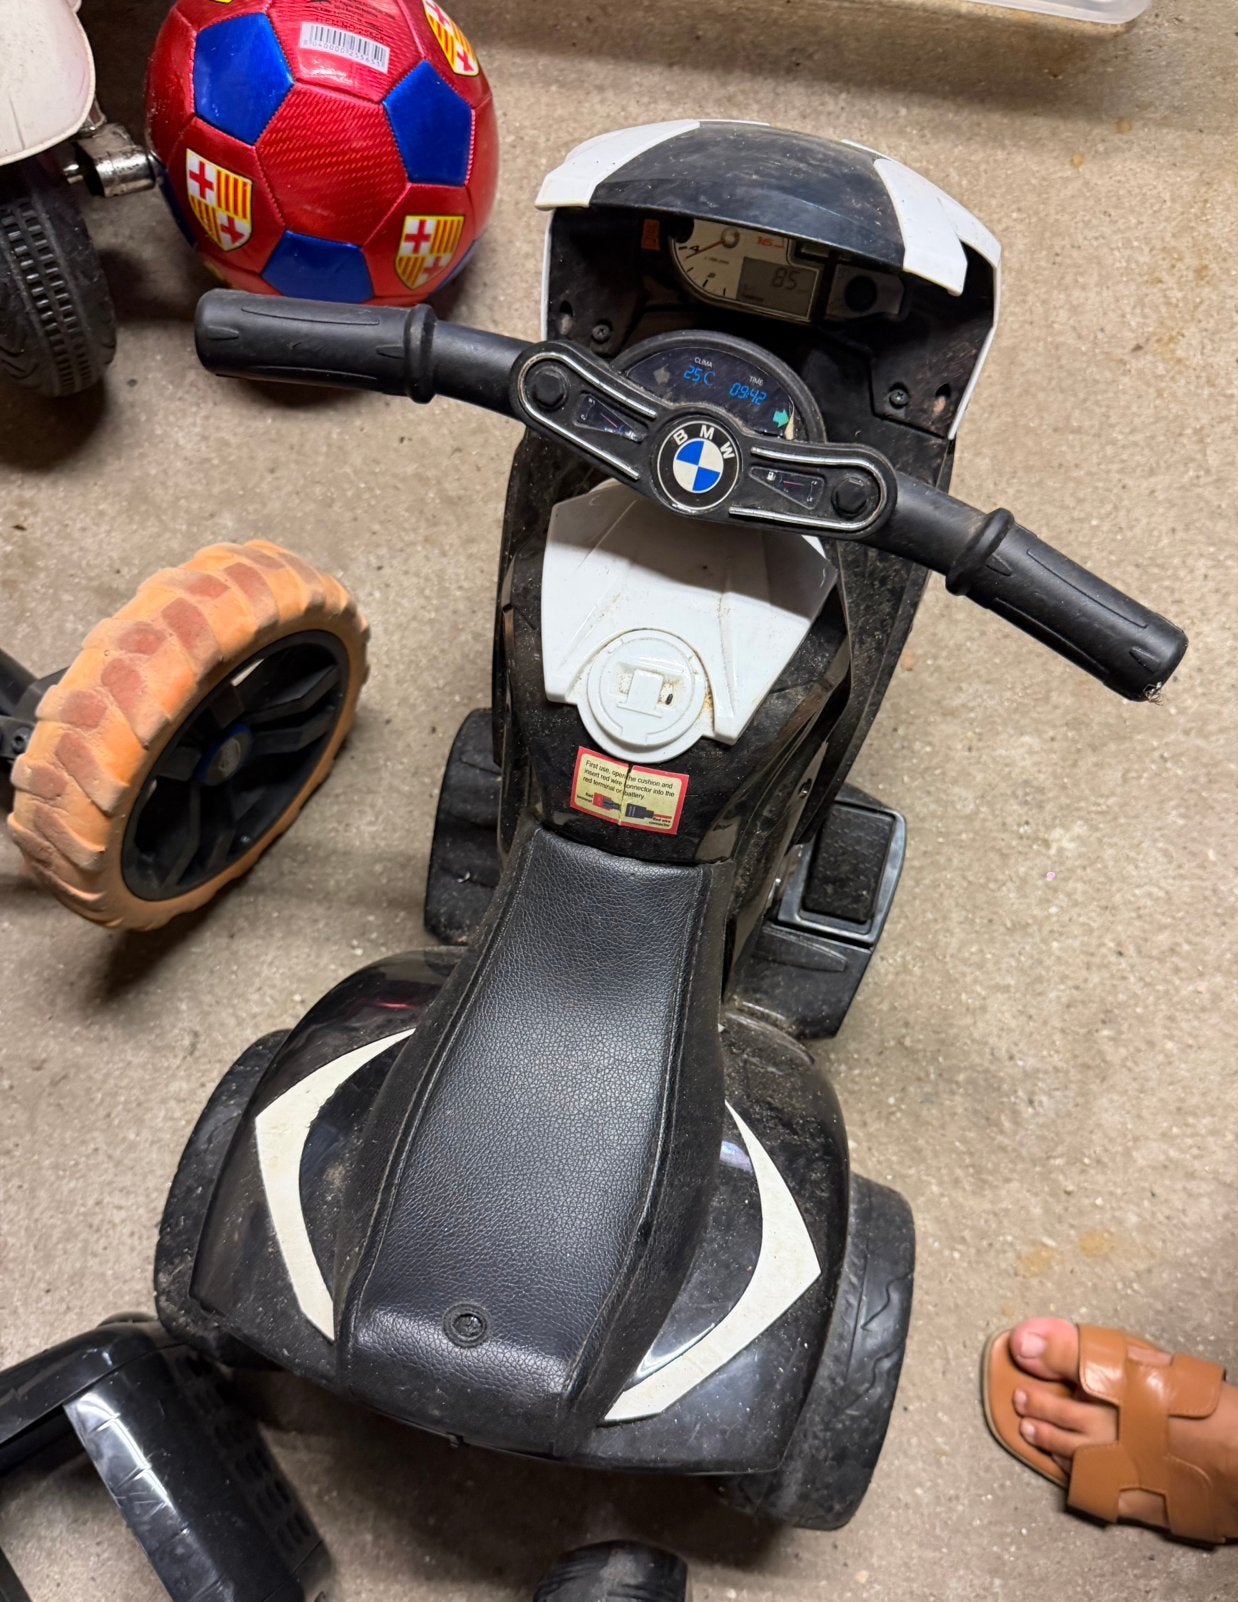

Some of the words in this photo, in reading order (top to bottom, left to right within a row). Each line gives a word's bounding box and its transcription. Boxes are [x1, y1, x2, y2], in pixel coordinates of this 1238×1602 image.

[772, 267, 799, 290] 85
[694, 356, 713, 368] CLIMA
[750, 375, 763, 386] TIME
[729, 382, 767, 406] 09:42
[673, 424, 735, 460] BMW
[582, 776, 593, 784] red
[593, 779, 615, 792] terminal
[584, 768, 600, 778] insert
[600, 774, 610, 782] red
[653, 788, 664, 796] into
[585, 759, 599, 769] First
[637, 777, 661, 787] cushion
[661, 782, 673, 790] and
